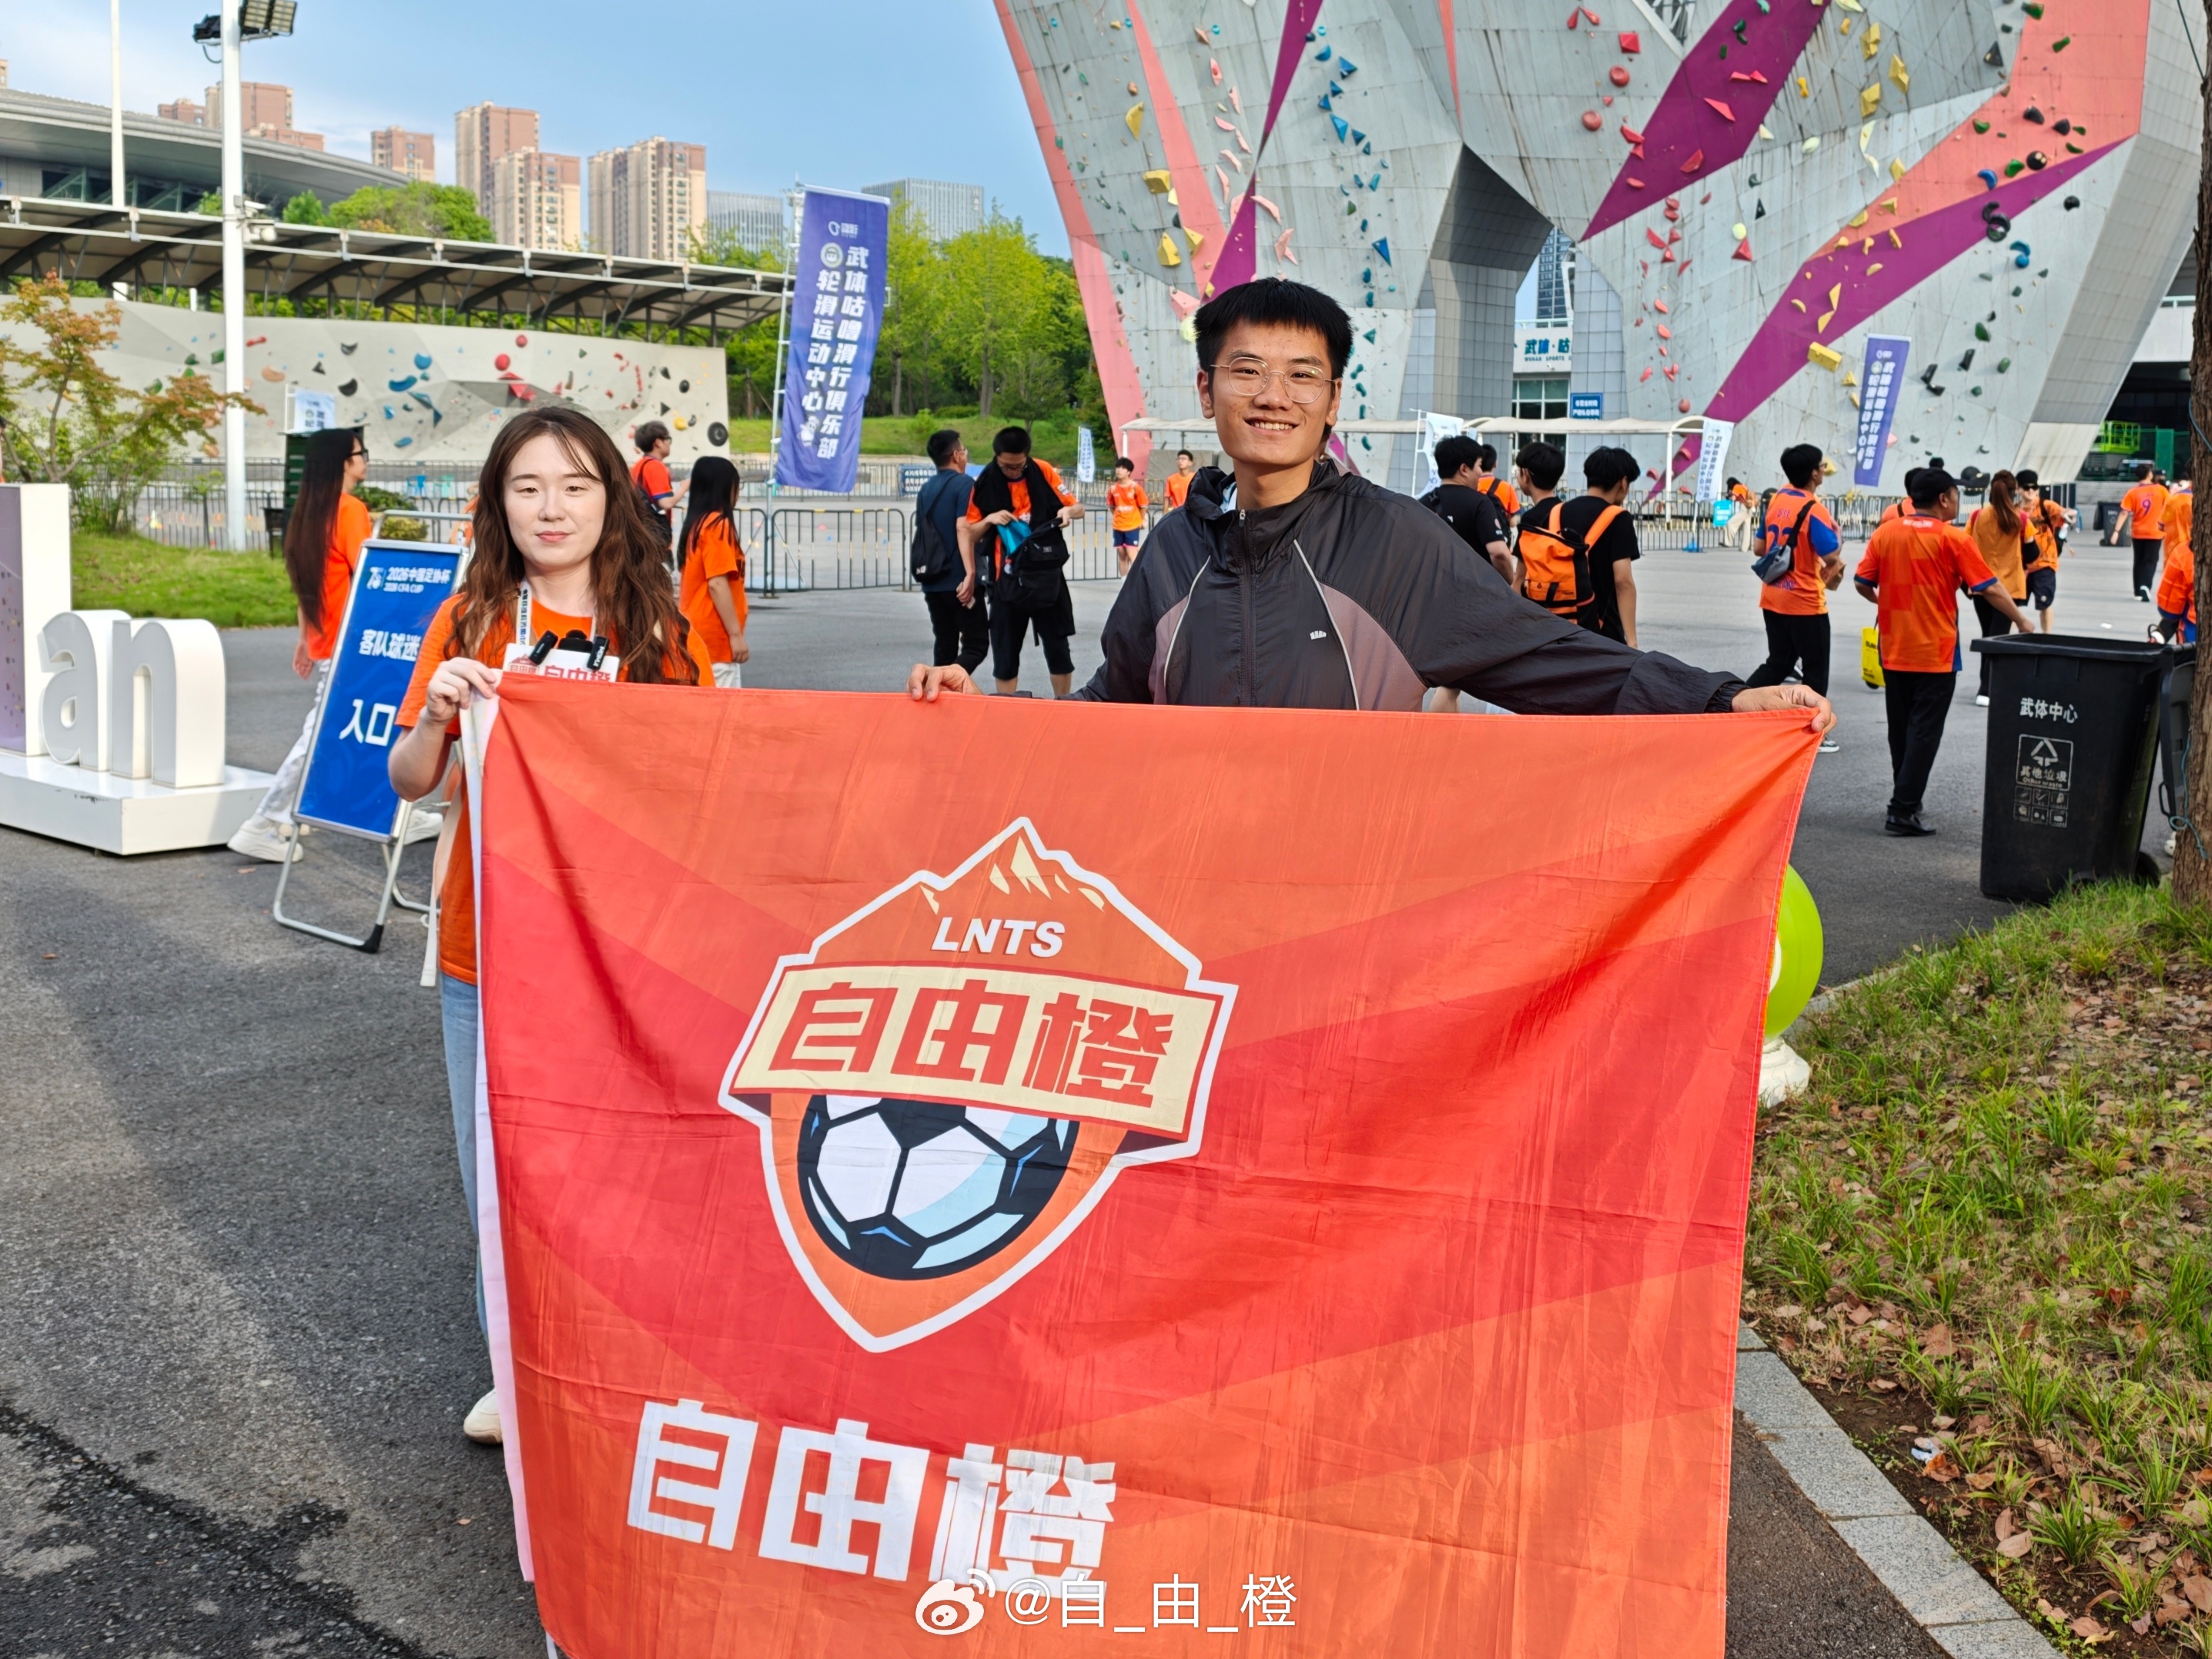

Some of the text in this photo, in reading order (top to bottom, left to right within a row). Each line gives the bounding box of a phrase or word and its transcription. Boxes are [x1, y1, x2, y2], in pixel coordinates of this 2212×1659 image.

[801, 269, 841, 412] 轮滑运动中心
[817, 246, 869, 460] 武体咕噜滑行俱乐部
[2142, 498, 2152, 517] 9
[359, 628, 423, 662] 客队球迷
[339, 698, 397, 747] 入口
[2020, 697, 2078, 724] 武体中心
[932, 916, 1065, 958] LNTS
[769, 980, 1175, 1108] 自由橙
[626, 1399, 1117, 1600] 自由橙
